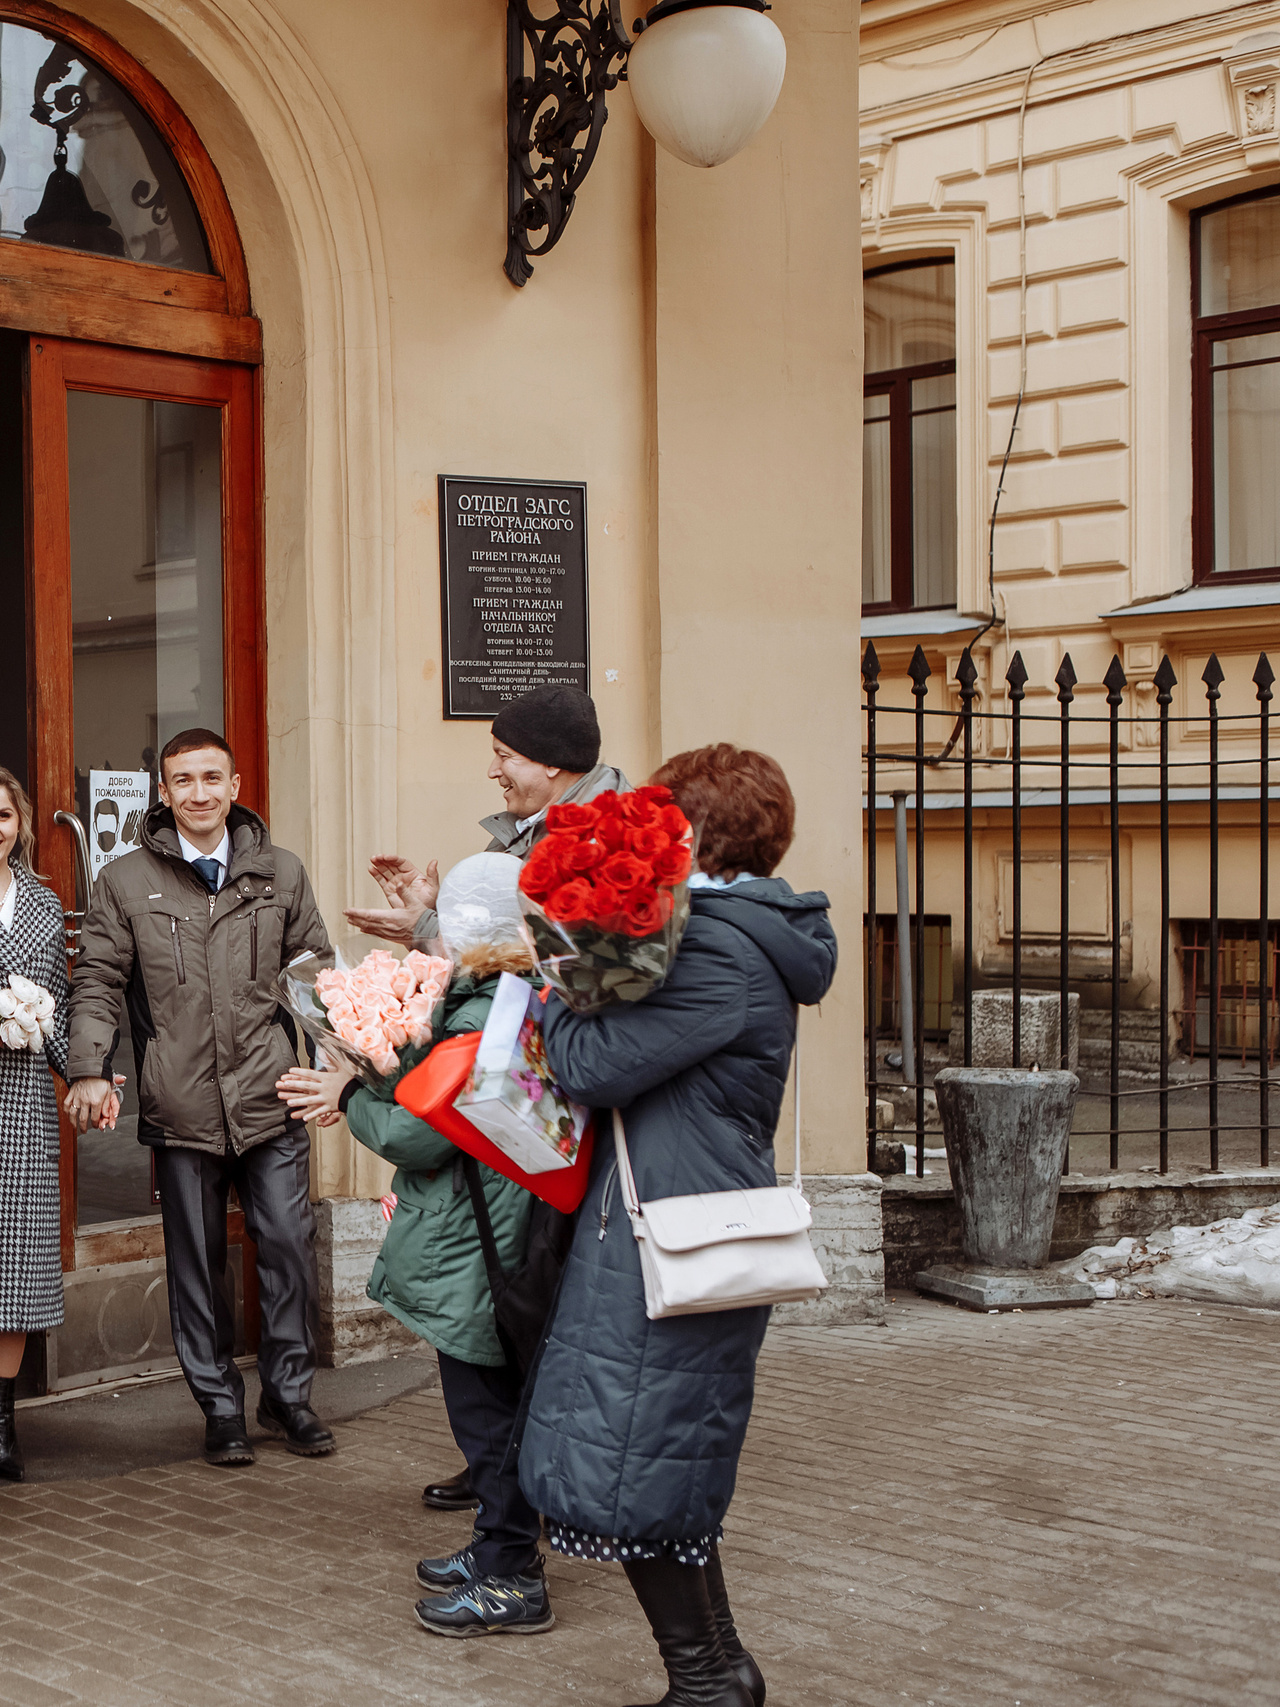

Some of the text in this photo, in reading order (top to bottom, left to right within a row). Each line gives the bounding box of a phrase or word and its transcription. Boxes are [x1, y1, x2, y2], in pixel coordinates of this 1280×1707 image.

[458, 494, 571, 516] ОТДЕЛ ЗАГС
[458, 514, 574, 531] ПЕТРОГРАДСКОГО
[490, 529, 541, 544] РАЙОНА
[472, 550, 561, 564] ПРИЕМ ГРАЖДАН
[473, 598, 563, 610] ПРИЕМ ГРАЖДАН
[481, 611, 556, 622] НАЧАЛЬНИКОМ
[484, 622, 554, 634] ОТДЕЛА ЗАГС
[108, 778, 133, 786] ДОБРО
[96, 788, 146, 798] ПОЖАЛОВАТЬ!
[96, 854, 100, 862] В
